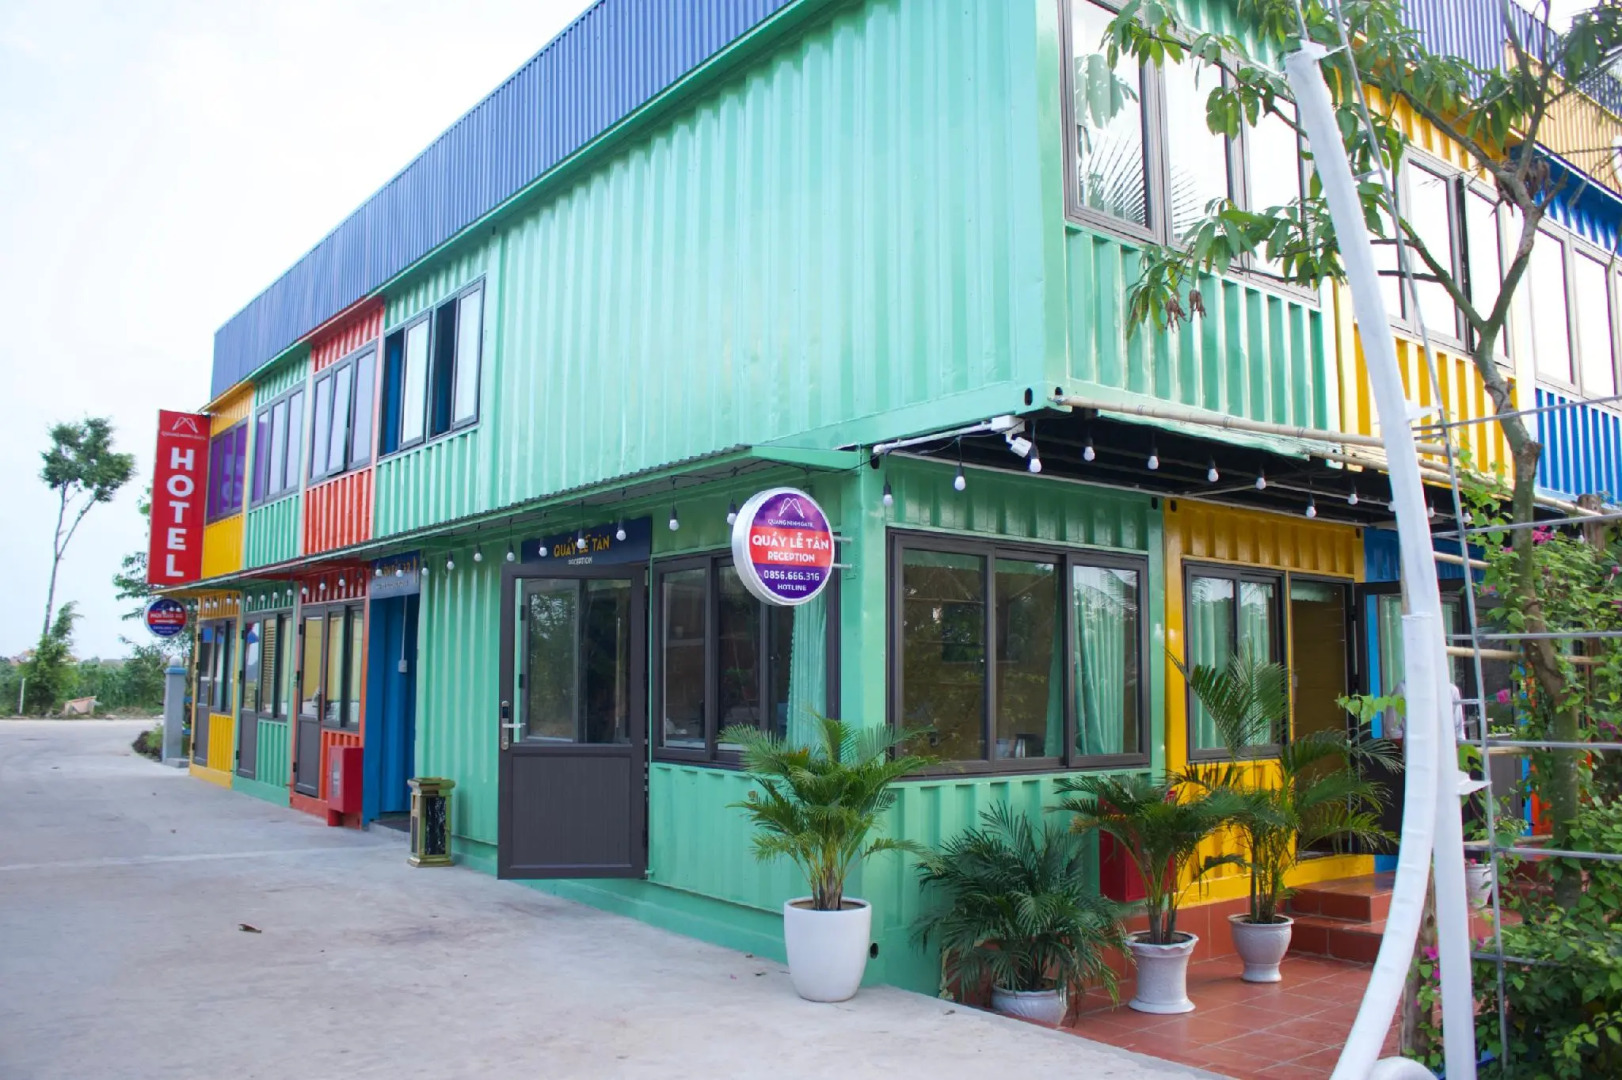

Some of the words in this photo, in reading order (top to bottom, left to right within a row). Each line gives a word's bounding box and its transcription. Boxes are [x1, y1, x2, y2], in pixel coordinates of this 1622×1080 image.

[166, 447, 194, 577] HOTEL
[806, 537, 829, 550] TÂN
[767, 551, 815, 563] RECEPTION
[763, 570, 820, 581] 0856.666.316
